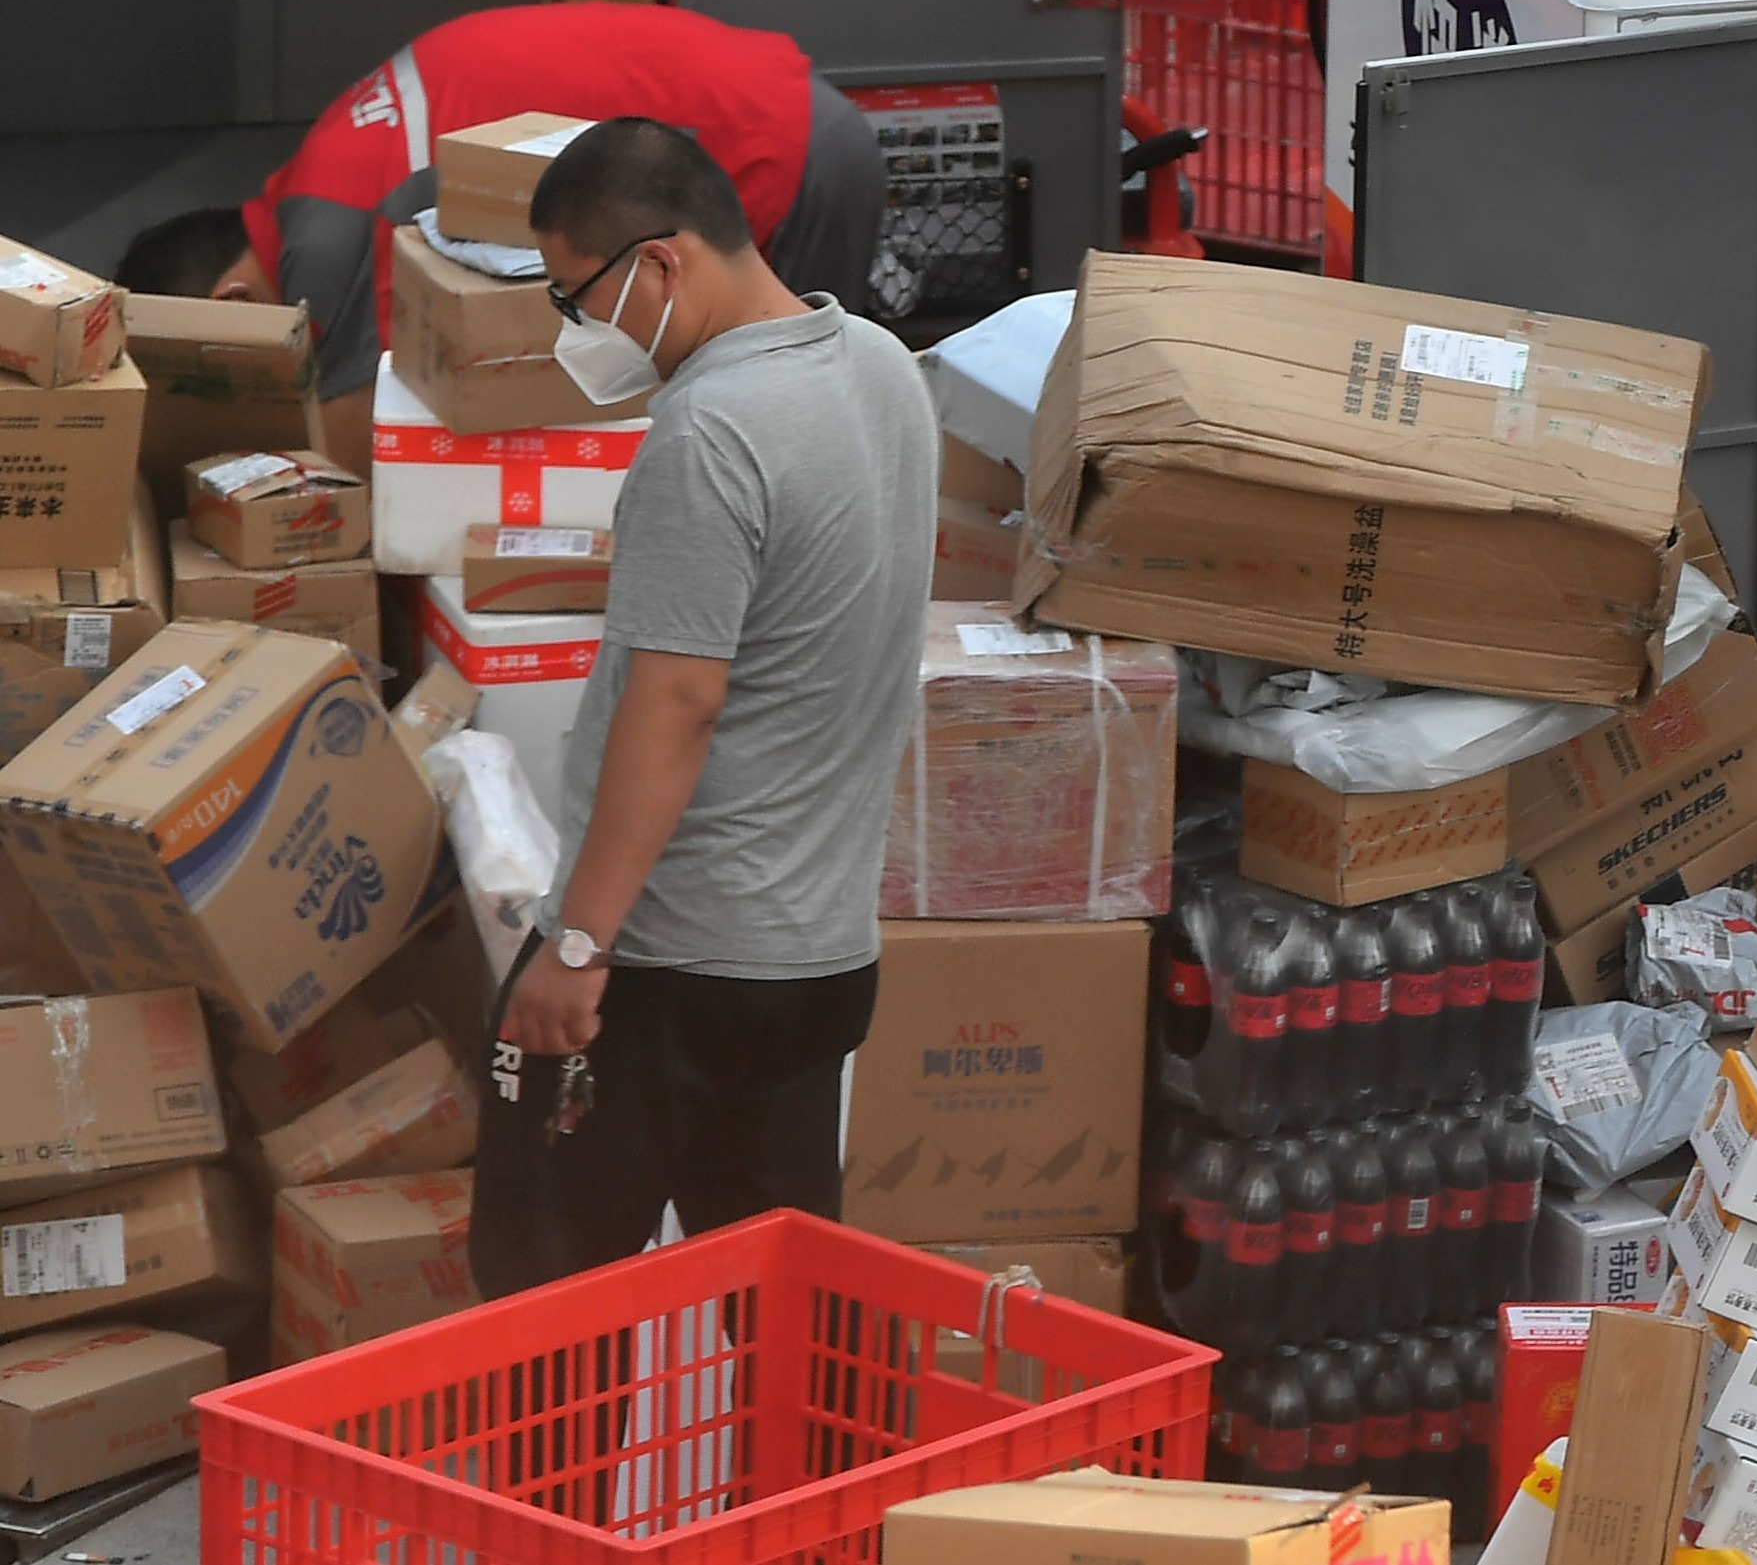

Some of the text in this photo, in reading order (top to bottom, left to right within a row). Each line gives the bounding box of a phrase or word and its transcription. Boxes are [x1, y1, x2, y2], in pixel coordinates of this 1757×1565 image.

[1337, 503, 1387, 660] 特大号洗澡盆
[1596, 782, 1729, 875] SKECHERS
[922, 1044, 1044, 1079] 阿尔卑斯
[950, 1022, 1021, 1045] ALPS
